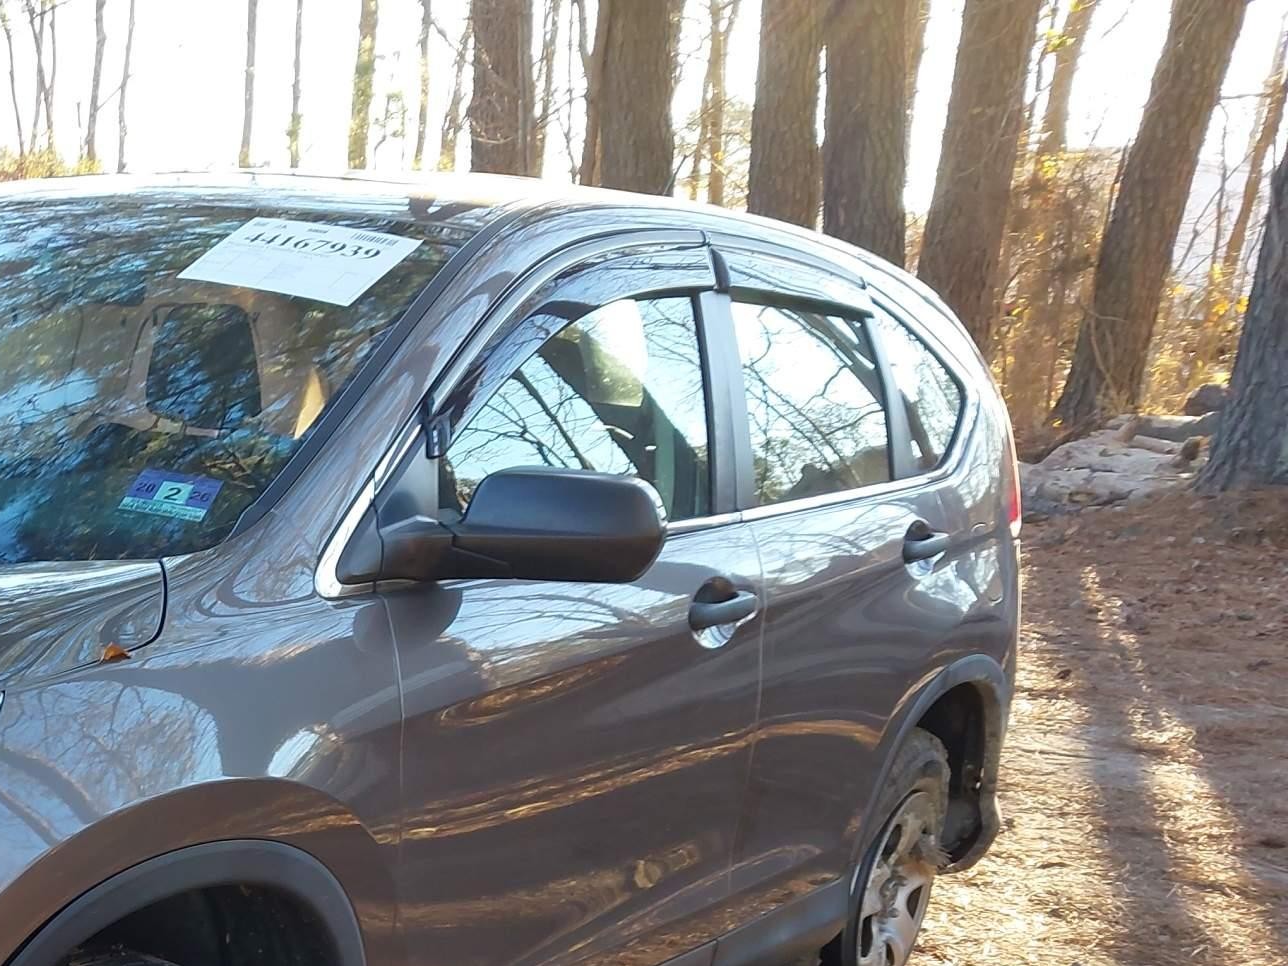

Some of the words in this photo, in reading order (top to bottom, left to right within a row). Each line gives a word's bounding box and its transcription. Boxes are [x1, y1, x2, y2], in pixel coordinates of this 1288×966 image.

[244, 231, 381, 260] 44167939
[135, 482, 156, 494] 20
[163, 487, 182, 501] 2
